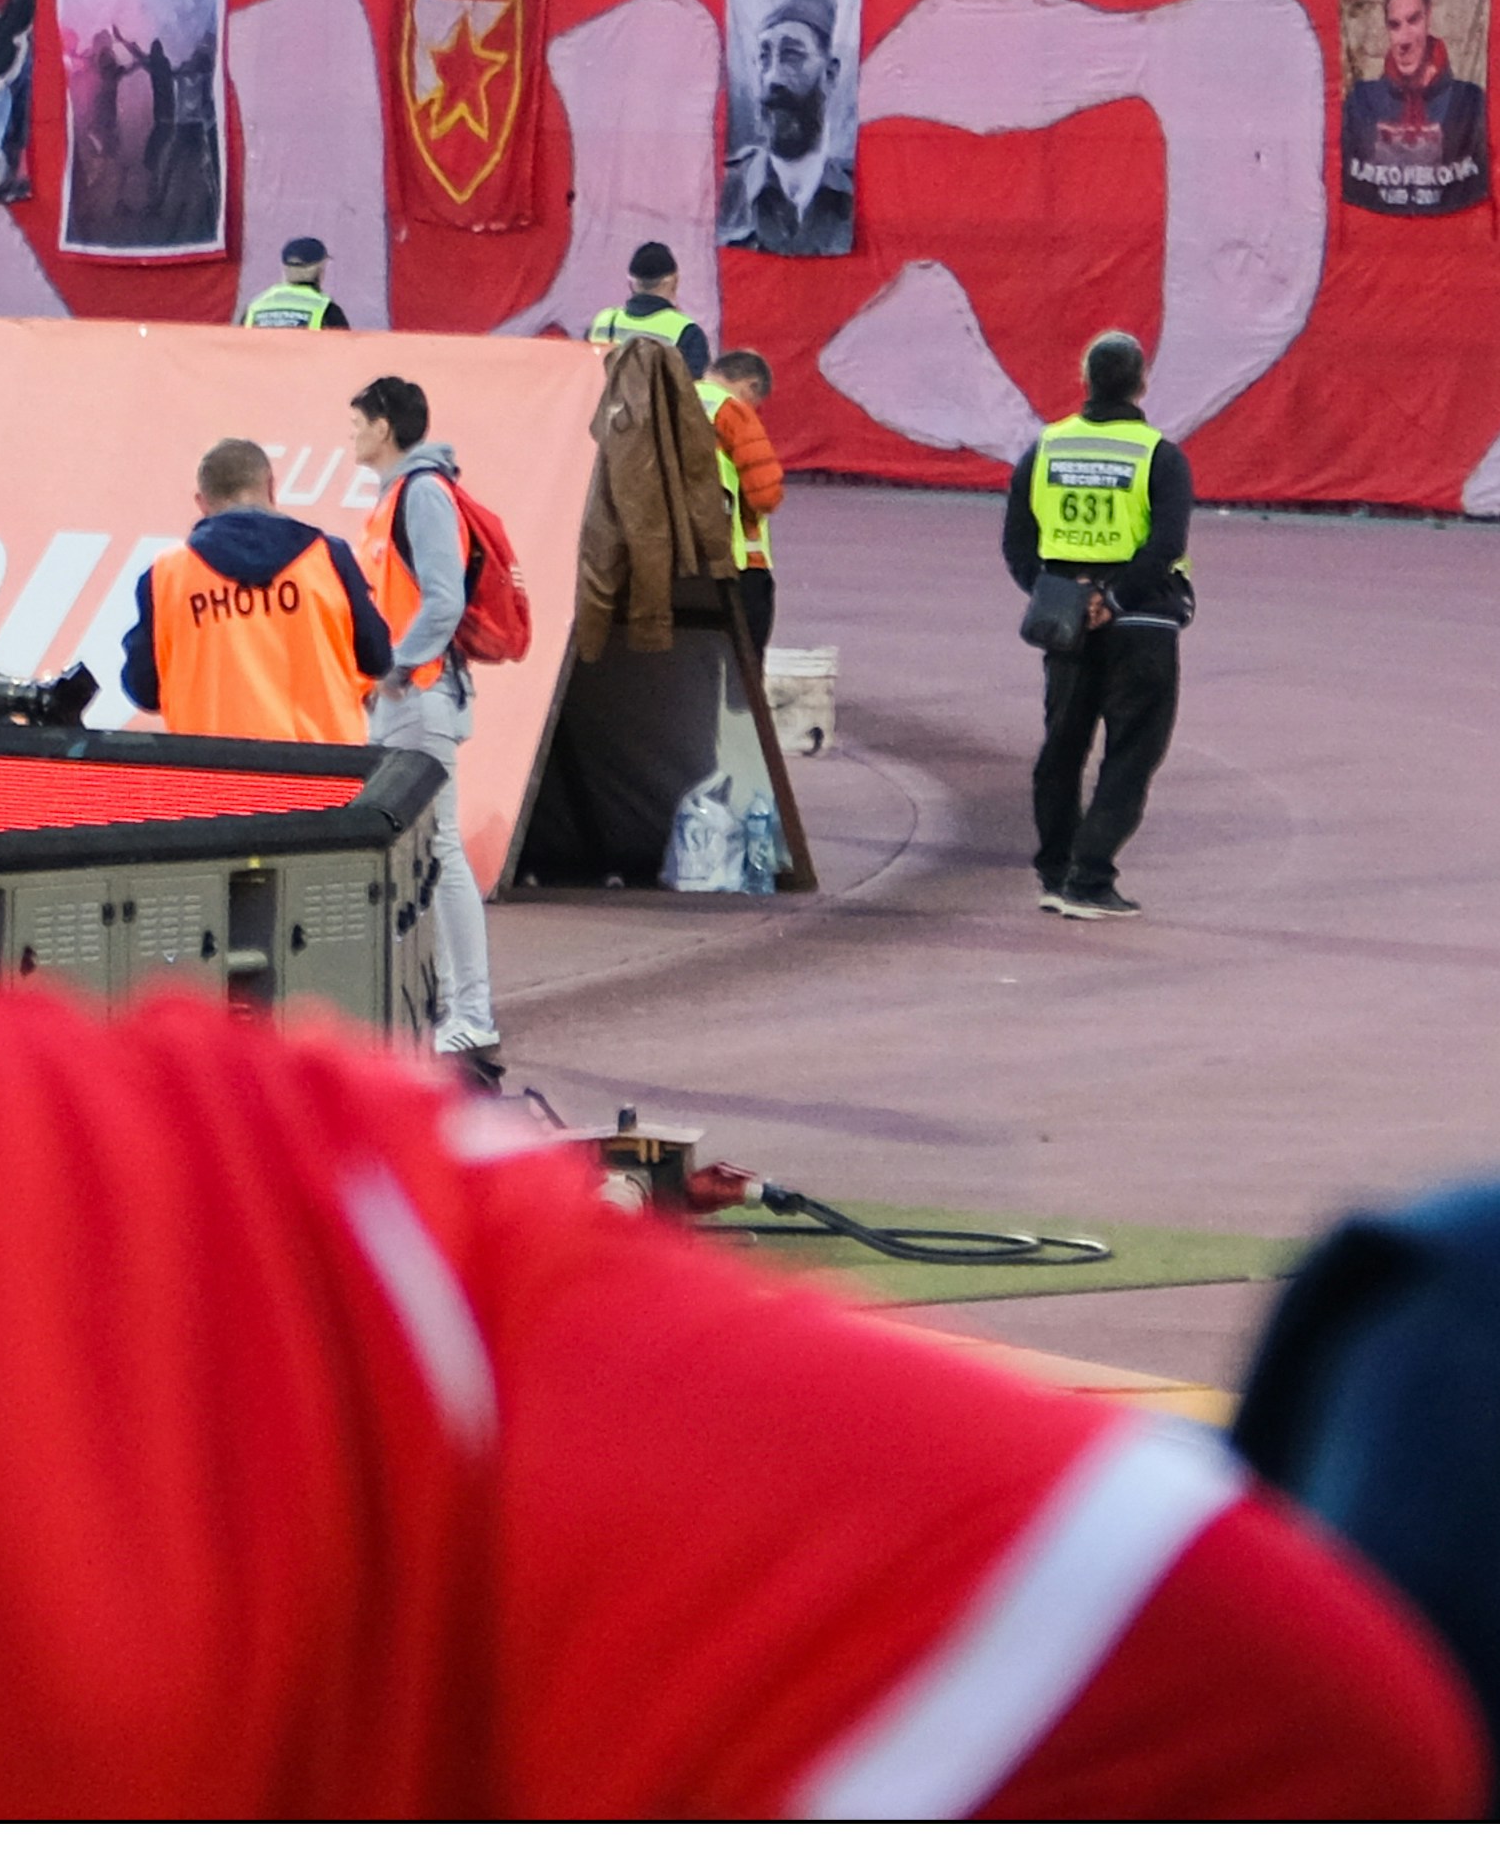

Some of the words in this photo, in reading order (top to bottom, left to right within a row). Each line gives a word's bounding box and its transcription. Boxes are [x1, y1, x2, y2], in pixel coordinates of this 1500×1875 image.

[1061, 492, 1115, 524] 631
[1053, 528, 1121, 547] РЕДАР
[189, 580, 300, 628] PHOTO
